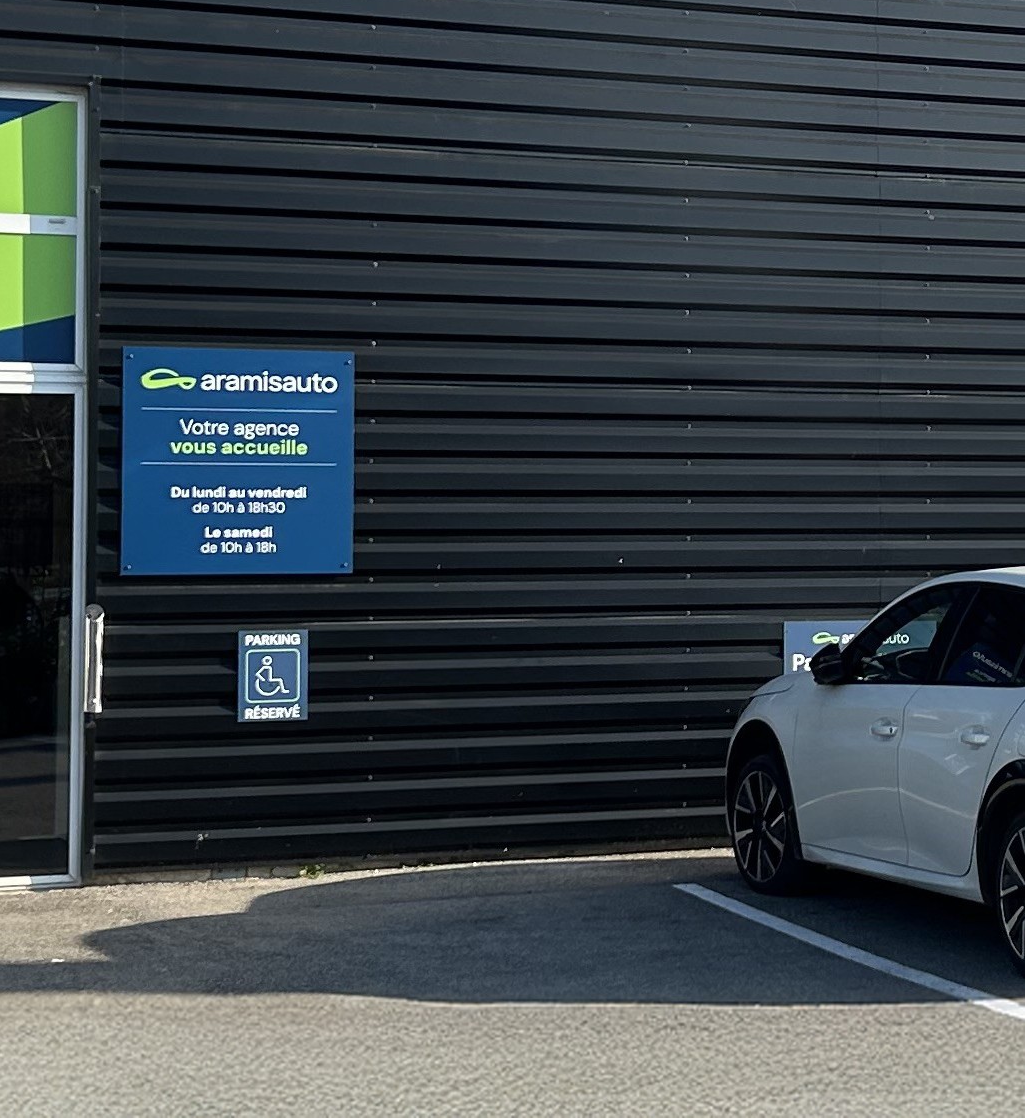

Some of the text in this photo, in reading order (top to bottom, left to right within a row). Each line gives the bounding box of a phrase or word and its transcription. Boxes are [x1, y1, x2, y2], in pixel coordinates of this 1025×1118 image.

[200, 370, 338, 394] aramisauto
[179, 418, 300, 440] Votre agence
[170, 439, 308, 456] vous accueille
[170, 486, 307, 499] Du lundi au vendredi
[192, 501, 286, 514] de 10h à 18h30
[204, 526, 273, 539] Le samedi
[200, 541, 277, 554] de 10h à 18h
[244, 633, 301, 646] PARKING
[244, 704, 301, 720] RÉSERVÉ
